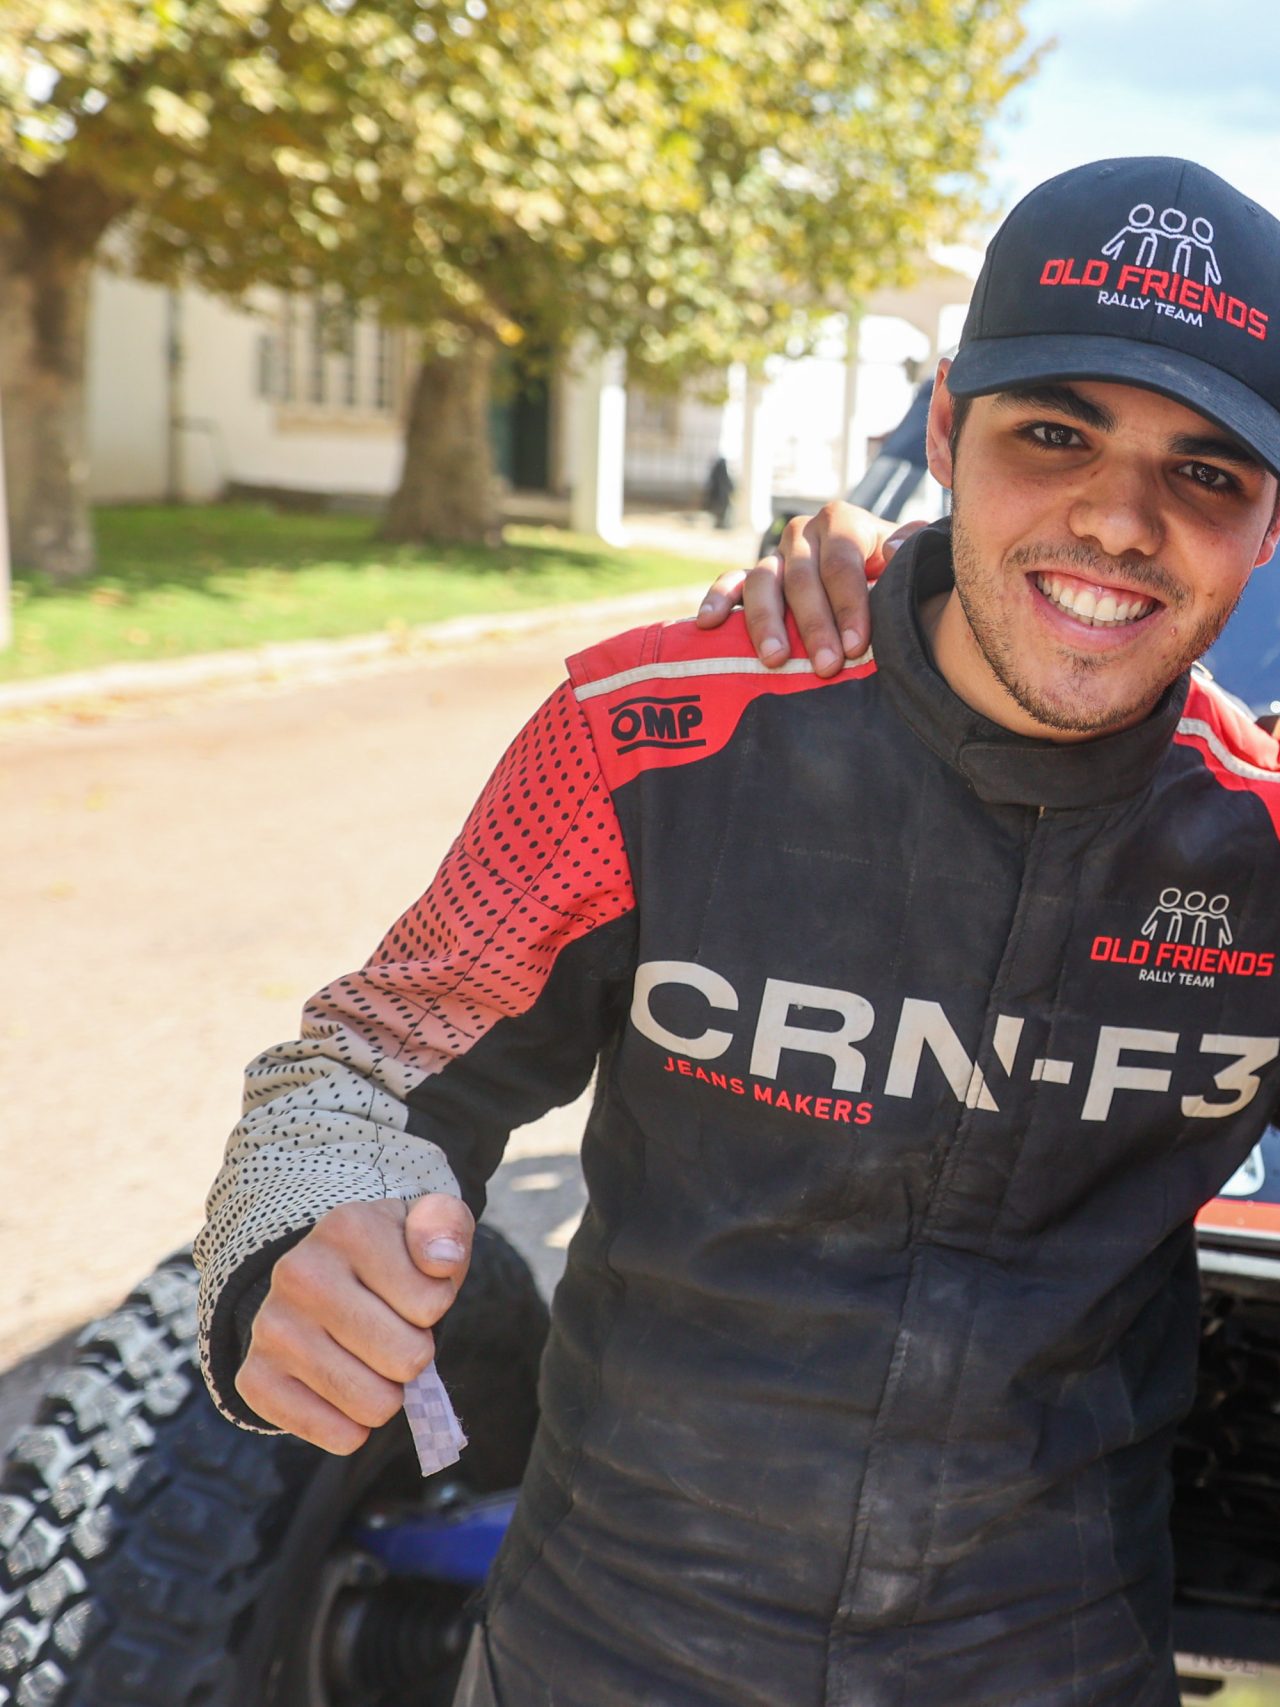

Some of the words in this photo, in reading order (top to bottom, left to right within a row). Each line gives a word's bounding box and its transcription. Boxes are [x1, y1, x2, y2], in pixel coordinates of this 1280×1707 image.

[1040, 258, 1110, 286] OLD
[1117, 265, 1269, 341] FRIENDS
[1097, 290, 1151, 311] RALLY
[1155, 301, 1203, 328] TEAM
[611, 705, 703, 742] OMP
[1090, 936, 1150, 965] OLD
[1155, 943, 1275, 977] FRIENDS
[1138, 968, 1175, 984] RALLY
[1179, 973, 1215, 989] TEAM
[630, 960, 1280, 1122] CRN-F3
[663, 1056, 746, 1095] JEANS
[753, 1083, 874, 1125] MAKERS
